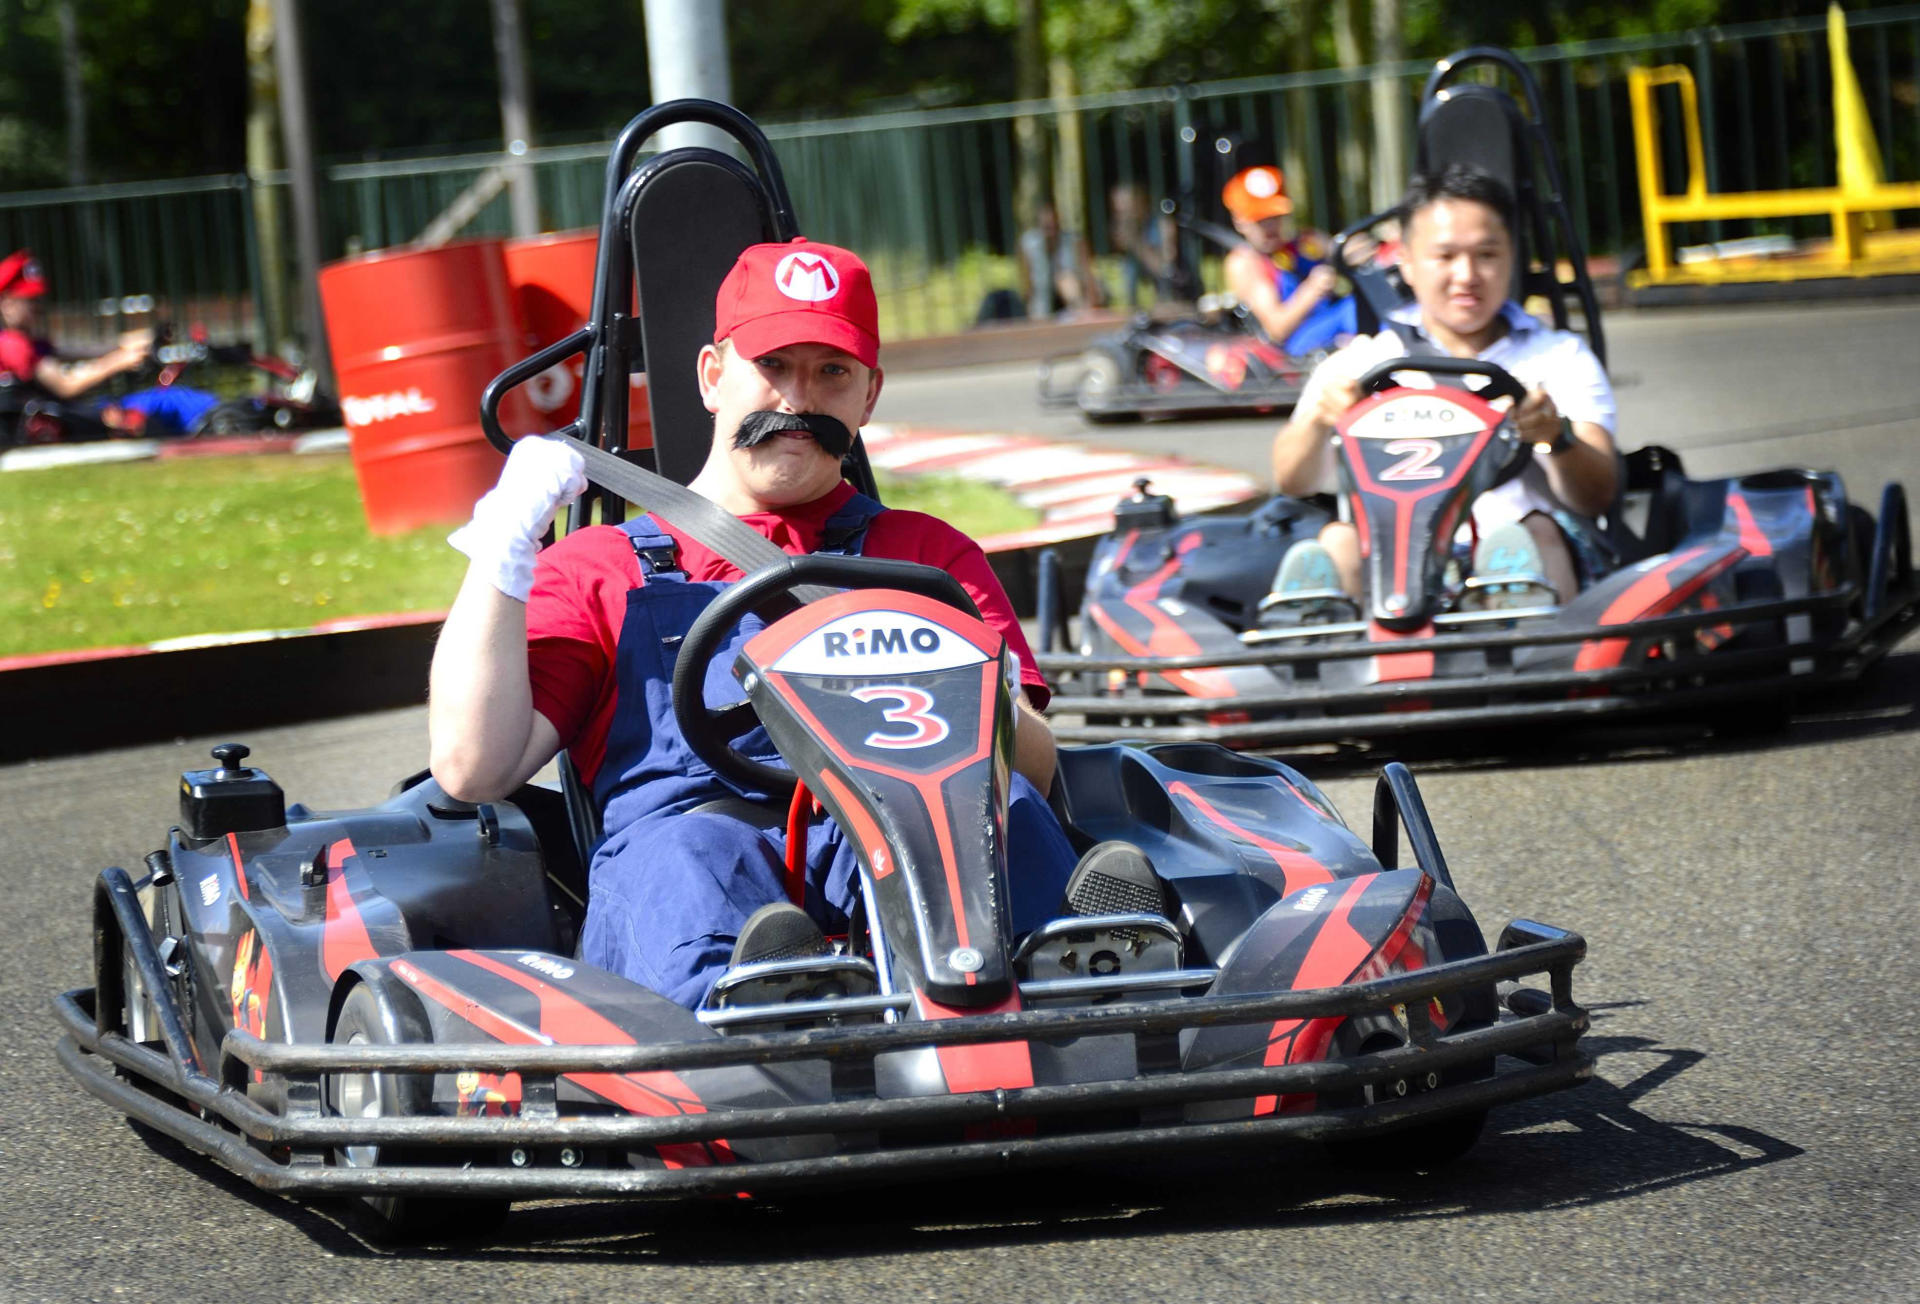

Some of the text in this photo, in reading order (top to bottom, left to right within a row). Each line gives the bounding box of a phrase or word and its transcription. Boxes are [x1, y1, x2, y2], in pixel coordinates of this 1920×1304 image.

[781, 256, 836, 292] M
[1377, 438, 1445, 481] 2
[849, 684, 950, 749] 3
